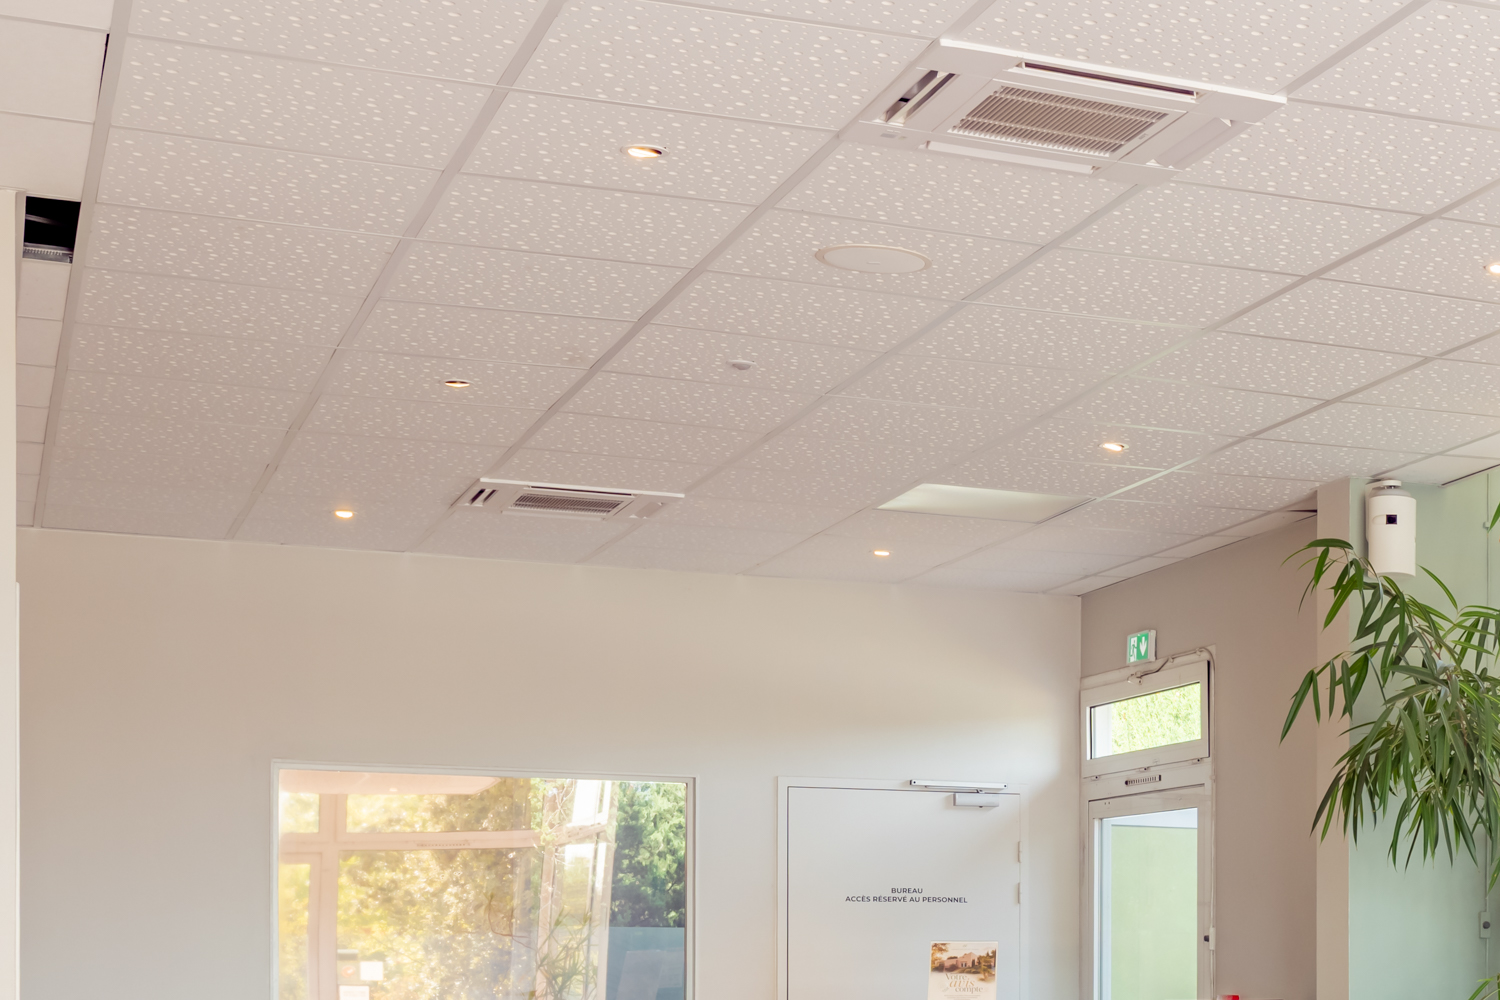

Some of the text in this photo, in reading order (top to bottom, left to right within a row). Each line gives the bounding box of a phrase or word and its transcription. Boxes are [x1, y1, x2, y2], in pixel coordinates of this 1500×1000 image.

[845, 895, 871, 903] ACCÈS
[872, 895, 907, 903] RÉSERVÉ
[922, 896, 968, 904] PERSONNEL
[945, 973, 967, 981] Votre
[949, 978, 975, 988] avis
[954, 986, 983, 994] compte
